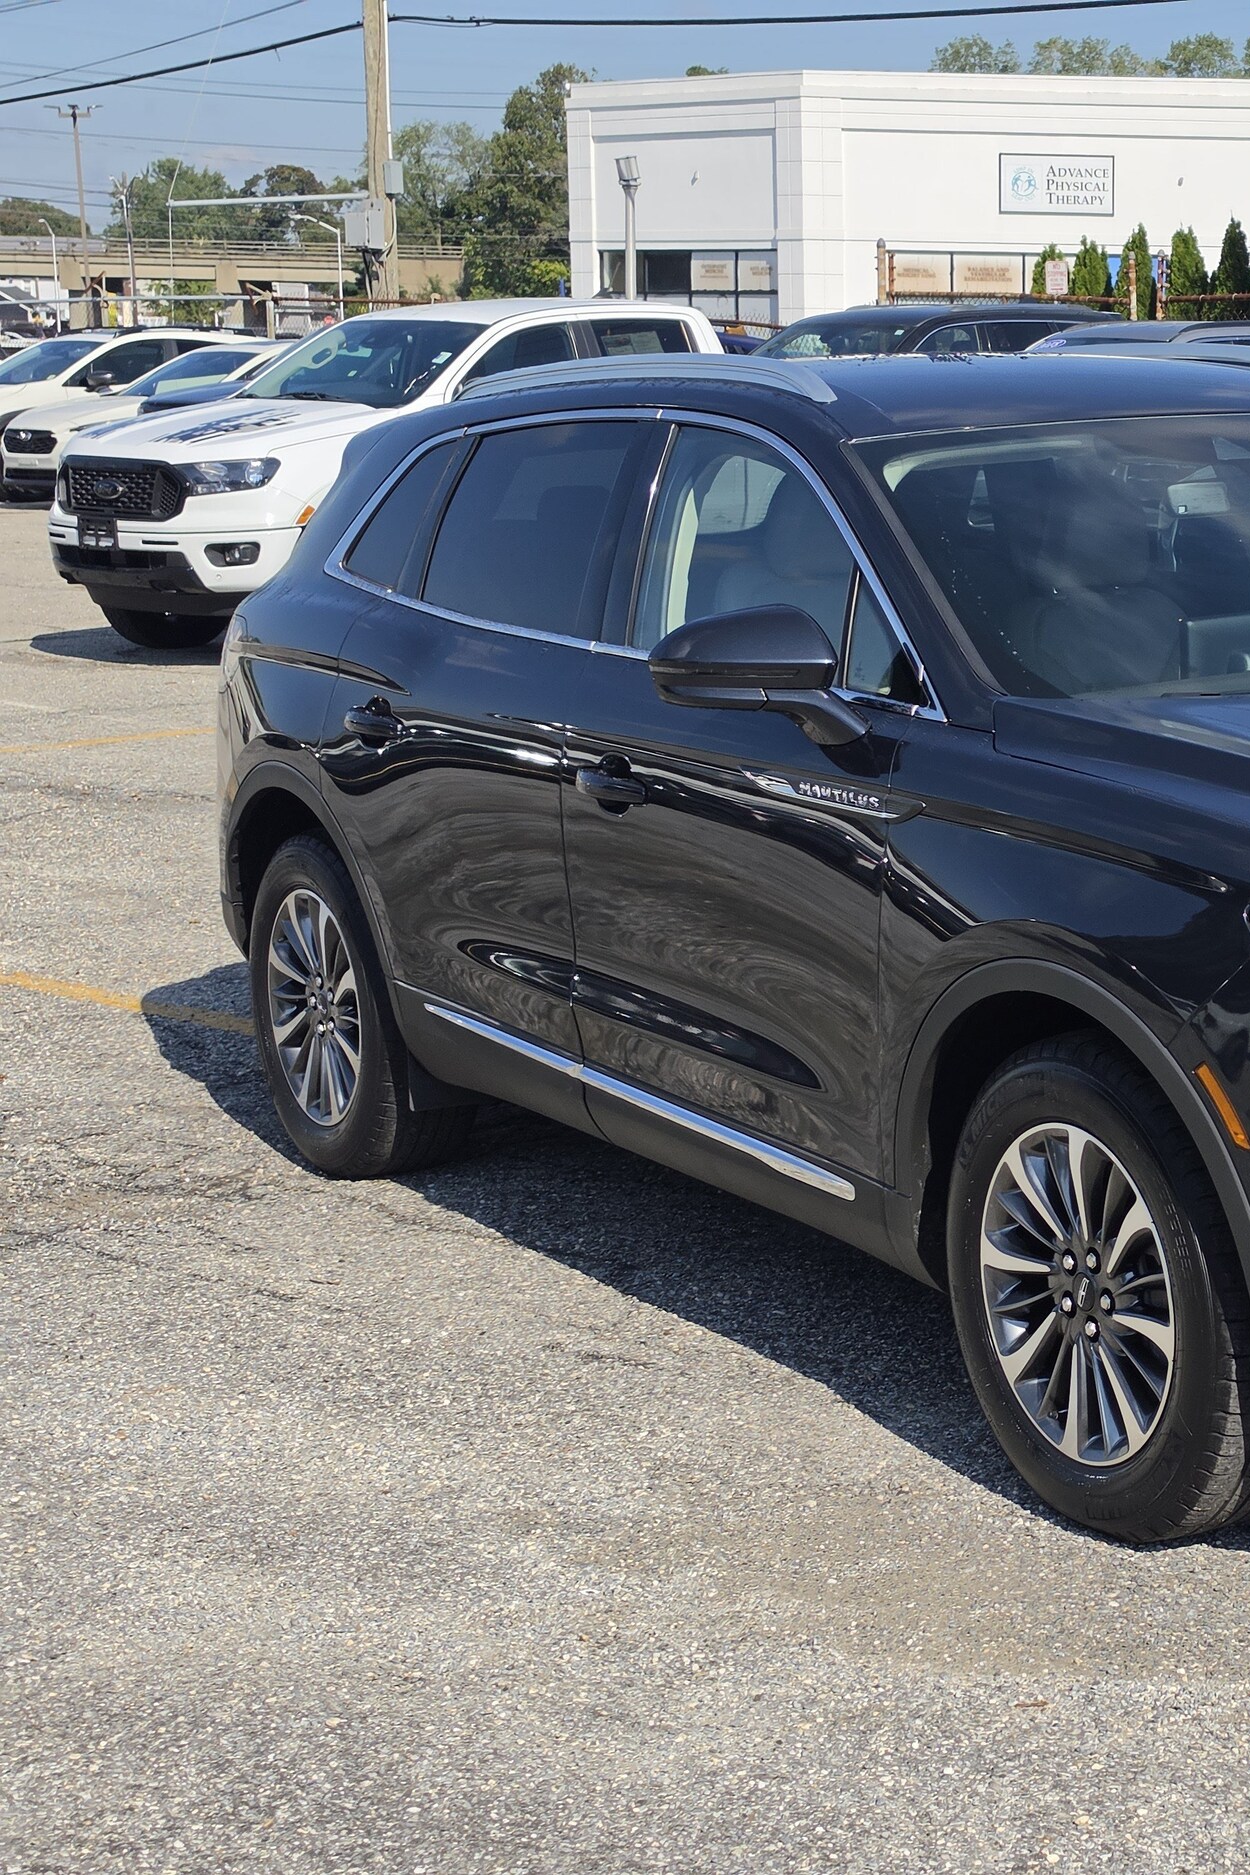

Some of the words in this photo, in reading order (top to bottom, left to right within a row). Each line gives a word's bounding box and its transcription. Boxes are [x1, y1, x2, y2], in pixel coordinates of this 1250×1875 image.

[1046, 165, 1109, 178] ADVANCE
[1046, 179, 1109, 192] PHYSICAL
[1046, 192, 1105, 206] THERAPY
[799, 781, 880, 808] NAUTILUS
